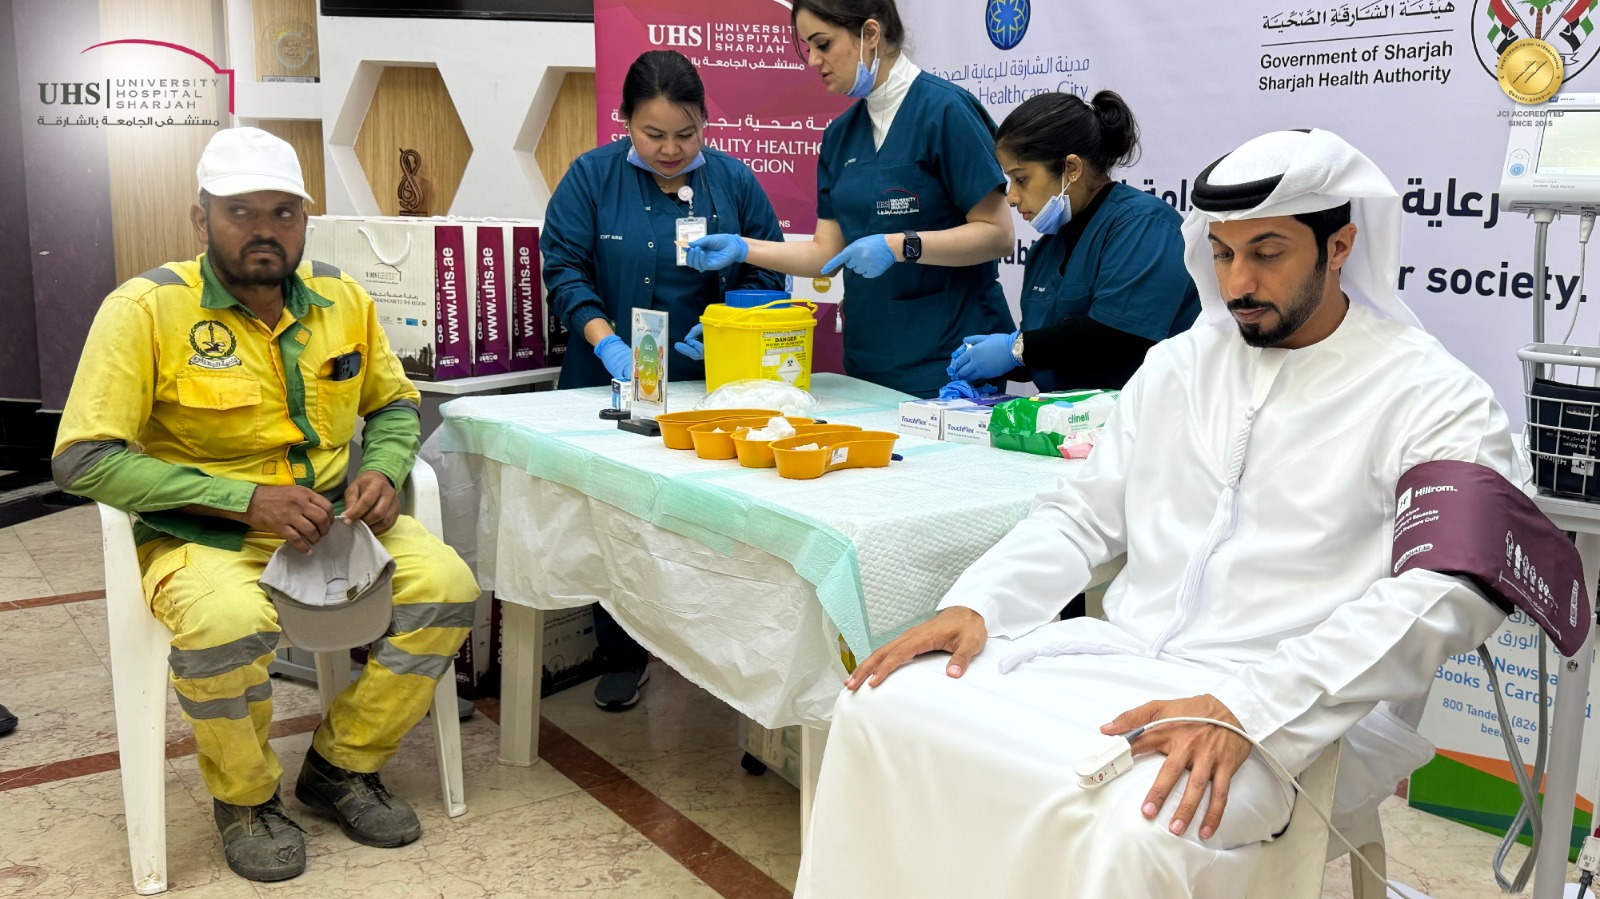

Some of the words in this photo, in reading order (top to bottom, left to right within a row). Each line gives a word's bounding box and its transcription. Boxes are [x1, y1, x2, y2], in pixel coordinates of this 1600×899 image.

[647, 24, 703, 47] UHS
[715, 23, 795, 34] UNIVERSIT
[715, 33, 790, 44] HOSPITAL
[715, 43, 785, 54] SHARJAH
[1260, 49, 1357, 69] Government
[1361, 45, 1379, 62] of
[1384, 41, 1453, 62] Sharjah
[702, 56, 748, 70] الجامعة
[971, 62, 1008, 84] للرعاية
[1010, 56, 1053, 81] الشارقة
[1055, 55, 1090, 77] مدينة
[1057, 80, 1089, 100] City
[1258, 75, 1314, 93] Sharjah
[1318, 69, 1369, 88] Health
[1372, 68, 1452, 85] Authority
[745, 114, 803, 132] صحية
[704, 138, 752, 153] ALITY
[756, 139, 823, 156] HEALTHC
[742, 158, 794, 174] EGION
[1402, 177, 1500, 229] رعاية
[442, 247, 460, 344] www.uhs.ae
[482, 247, 498, 341] www.uhs.ae
[518, 246, 534, 337] www.uhs.ae
[437, 324, 444, 344] 06
[901, 415, 927, 426] TouchFlex
[1067, 411, 1090, 424] clinell
[947, 423, 975, 434] TouchFlex
[1498, 630, 1538, 650] الورق
[1448, 653, 1487, 670] aper,
[1435, 665, 1480, 689] Books
[1442, 697, 1464, 712] 800
